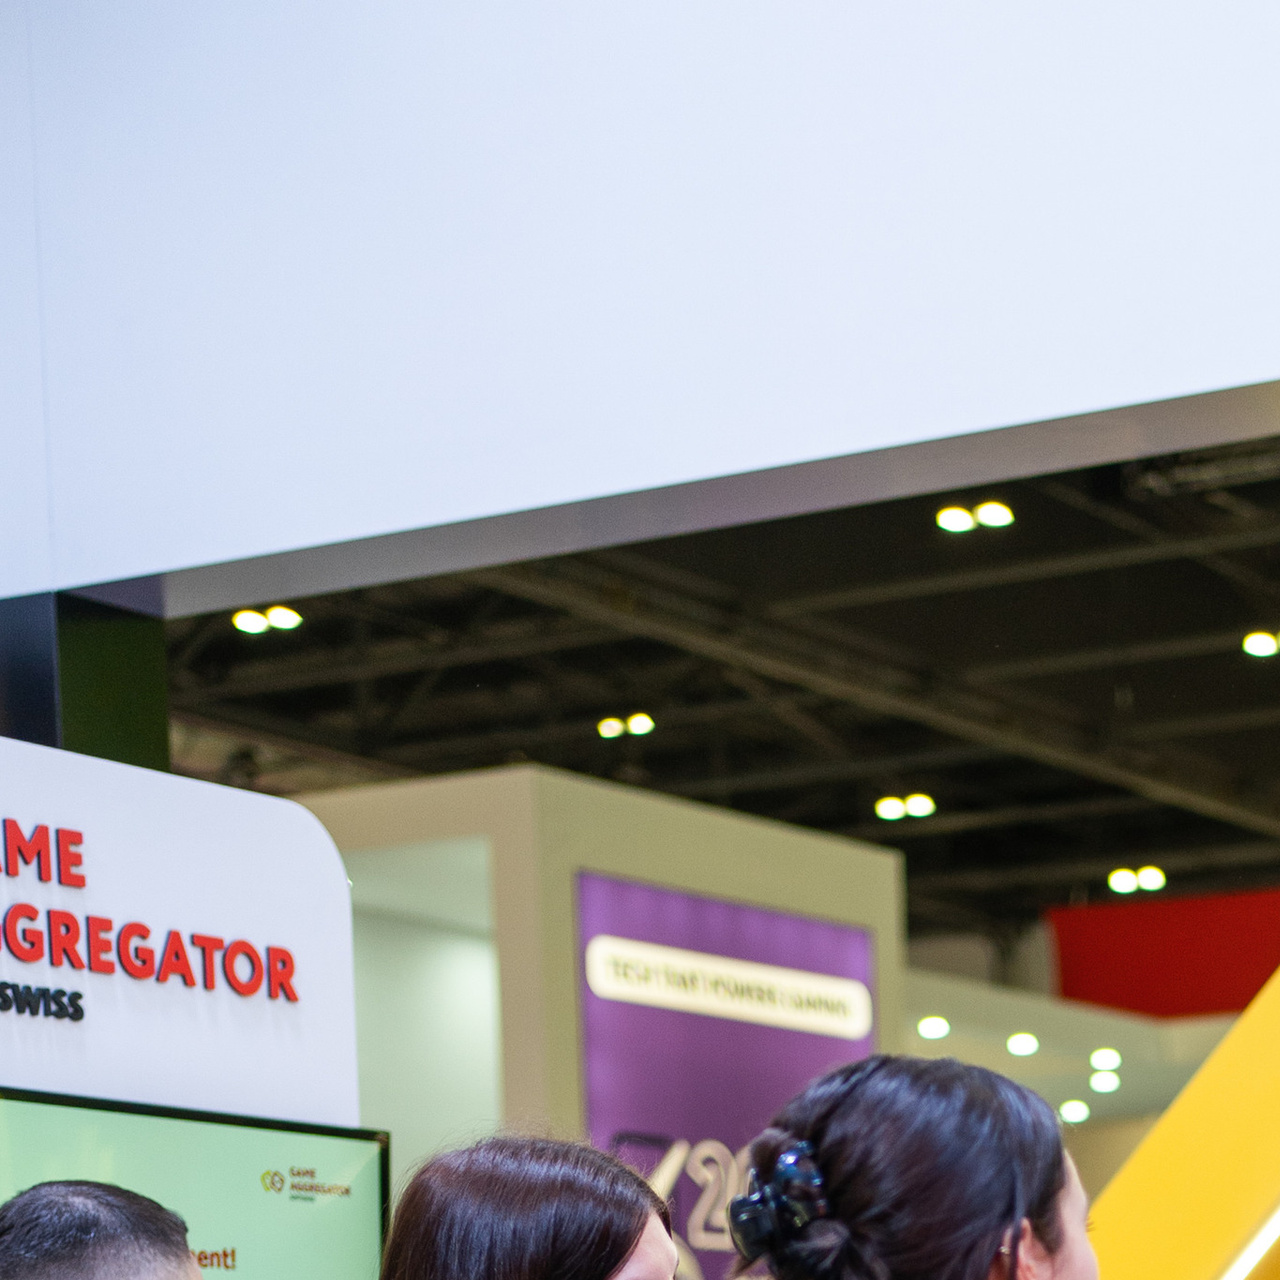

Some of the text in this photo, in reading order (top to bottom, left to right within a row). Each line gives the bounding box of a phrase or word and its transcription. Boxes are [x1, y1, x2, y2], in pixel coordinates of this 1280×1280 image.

[0, 818, 86, 888] ME
[0, 903, 299, 1002] GREGATOR
[190, 1248, 237, 1270] ent!
